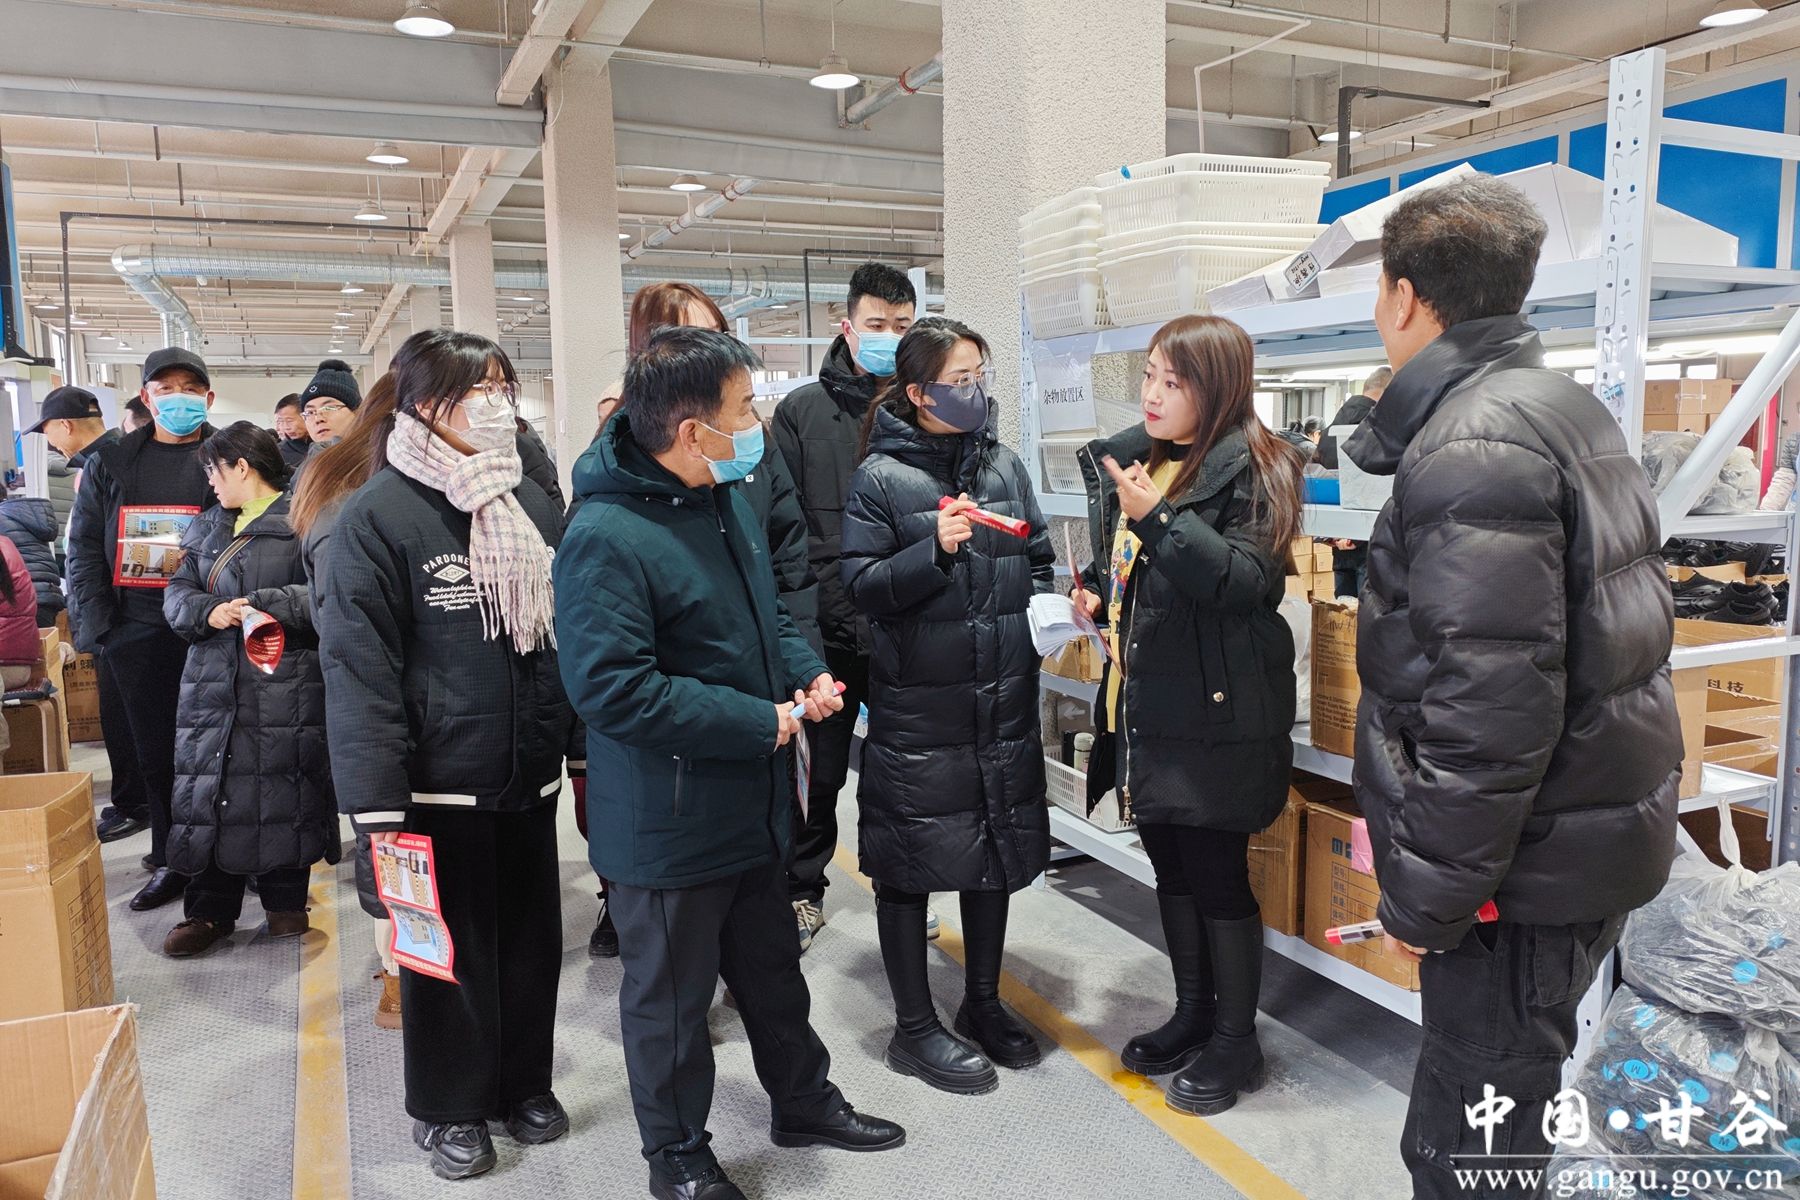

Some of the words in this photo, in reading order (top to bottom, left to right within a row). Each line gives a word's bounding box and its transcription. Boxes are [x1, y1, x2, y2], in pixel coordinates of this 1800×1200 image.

[1043, 386, 1085, 405] 杂物放置区
[422, 553, 470, 574] PARDONE
[1707, 678, 1744, 693] 科技
